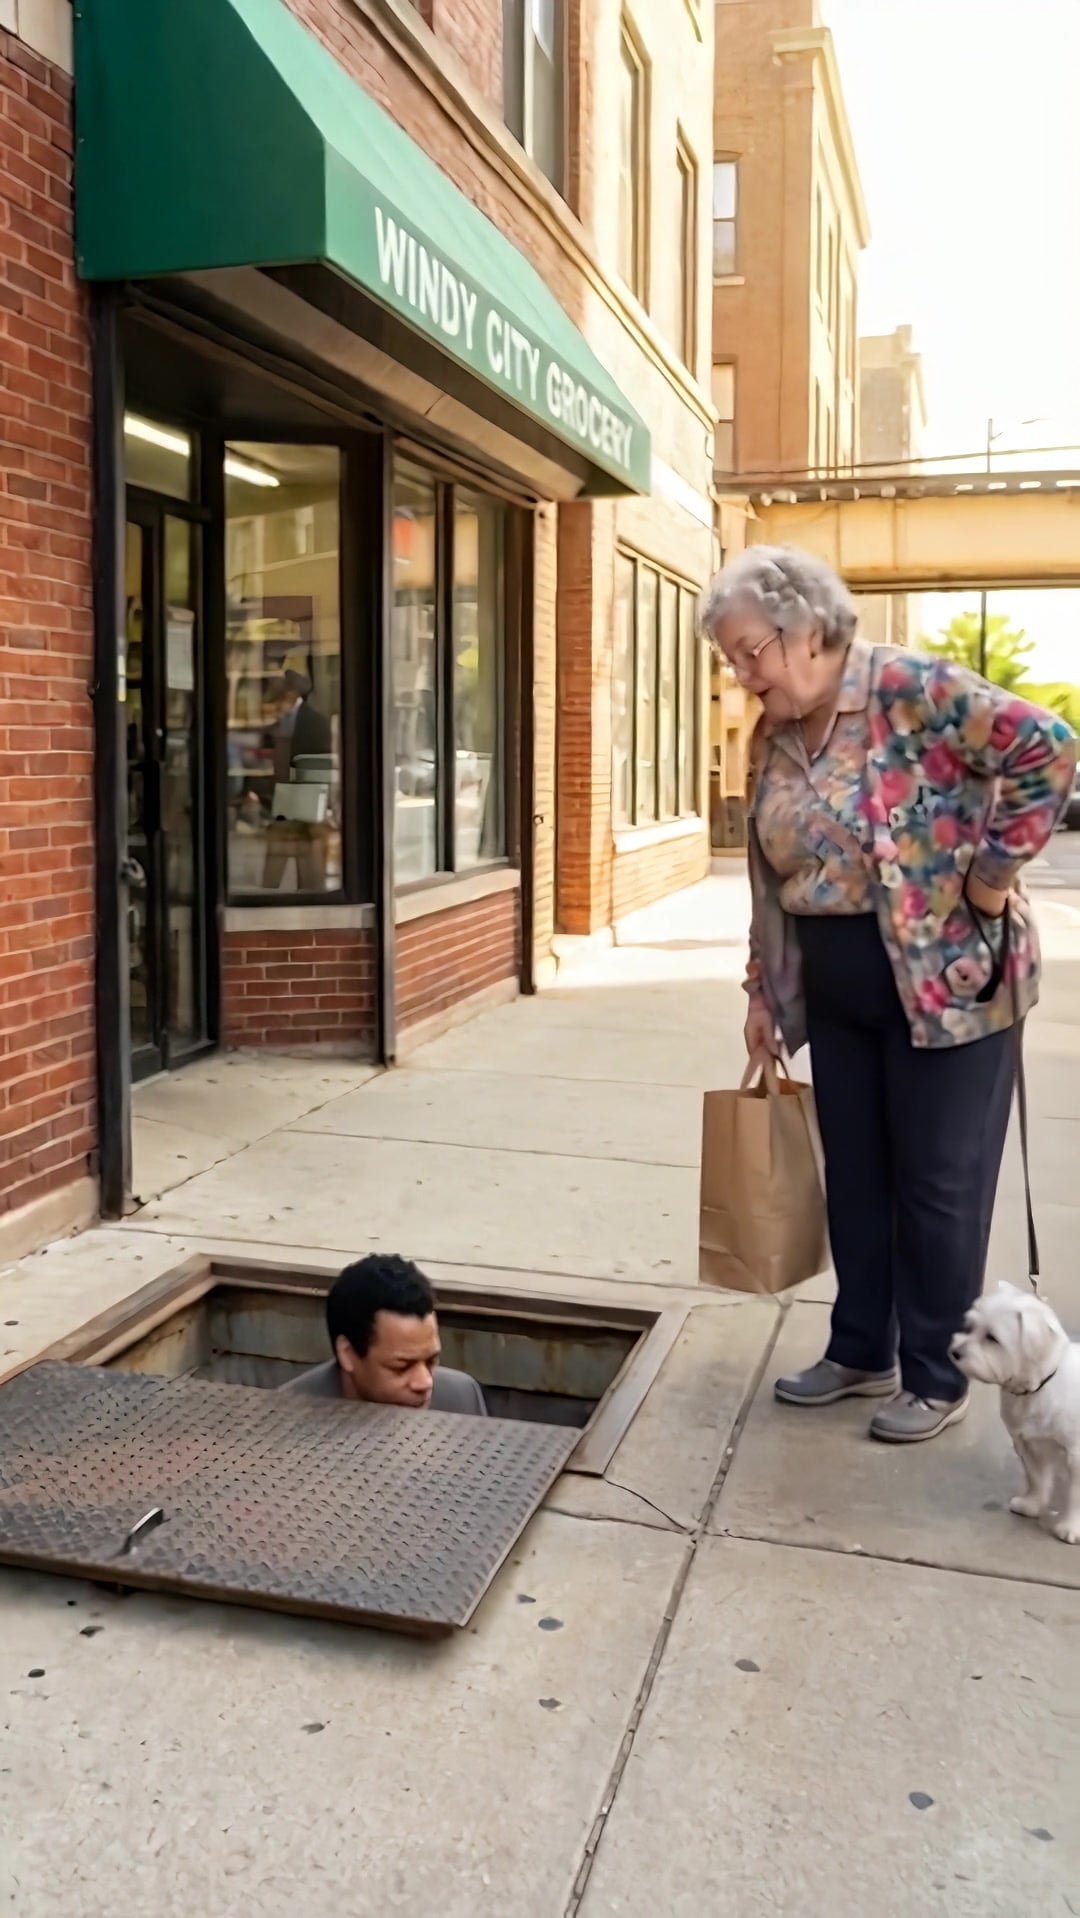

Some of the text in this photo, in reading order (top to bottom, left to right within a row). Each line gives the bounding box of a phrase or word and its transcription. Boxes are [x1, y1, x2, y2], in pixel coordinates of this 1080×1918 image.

[374, 206, 633, 470] WINDY CITY GROCERY
